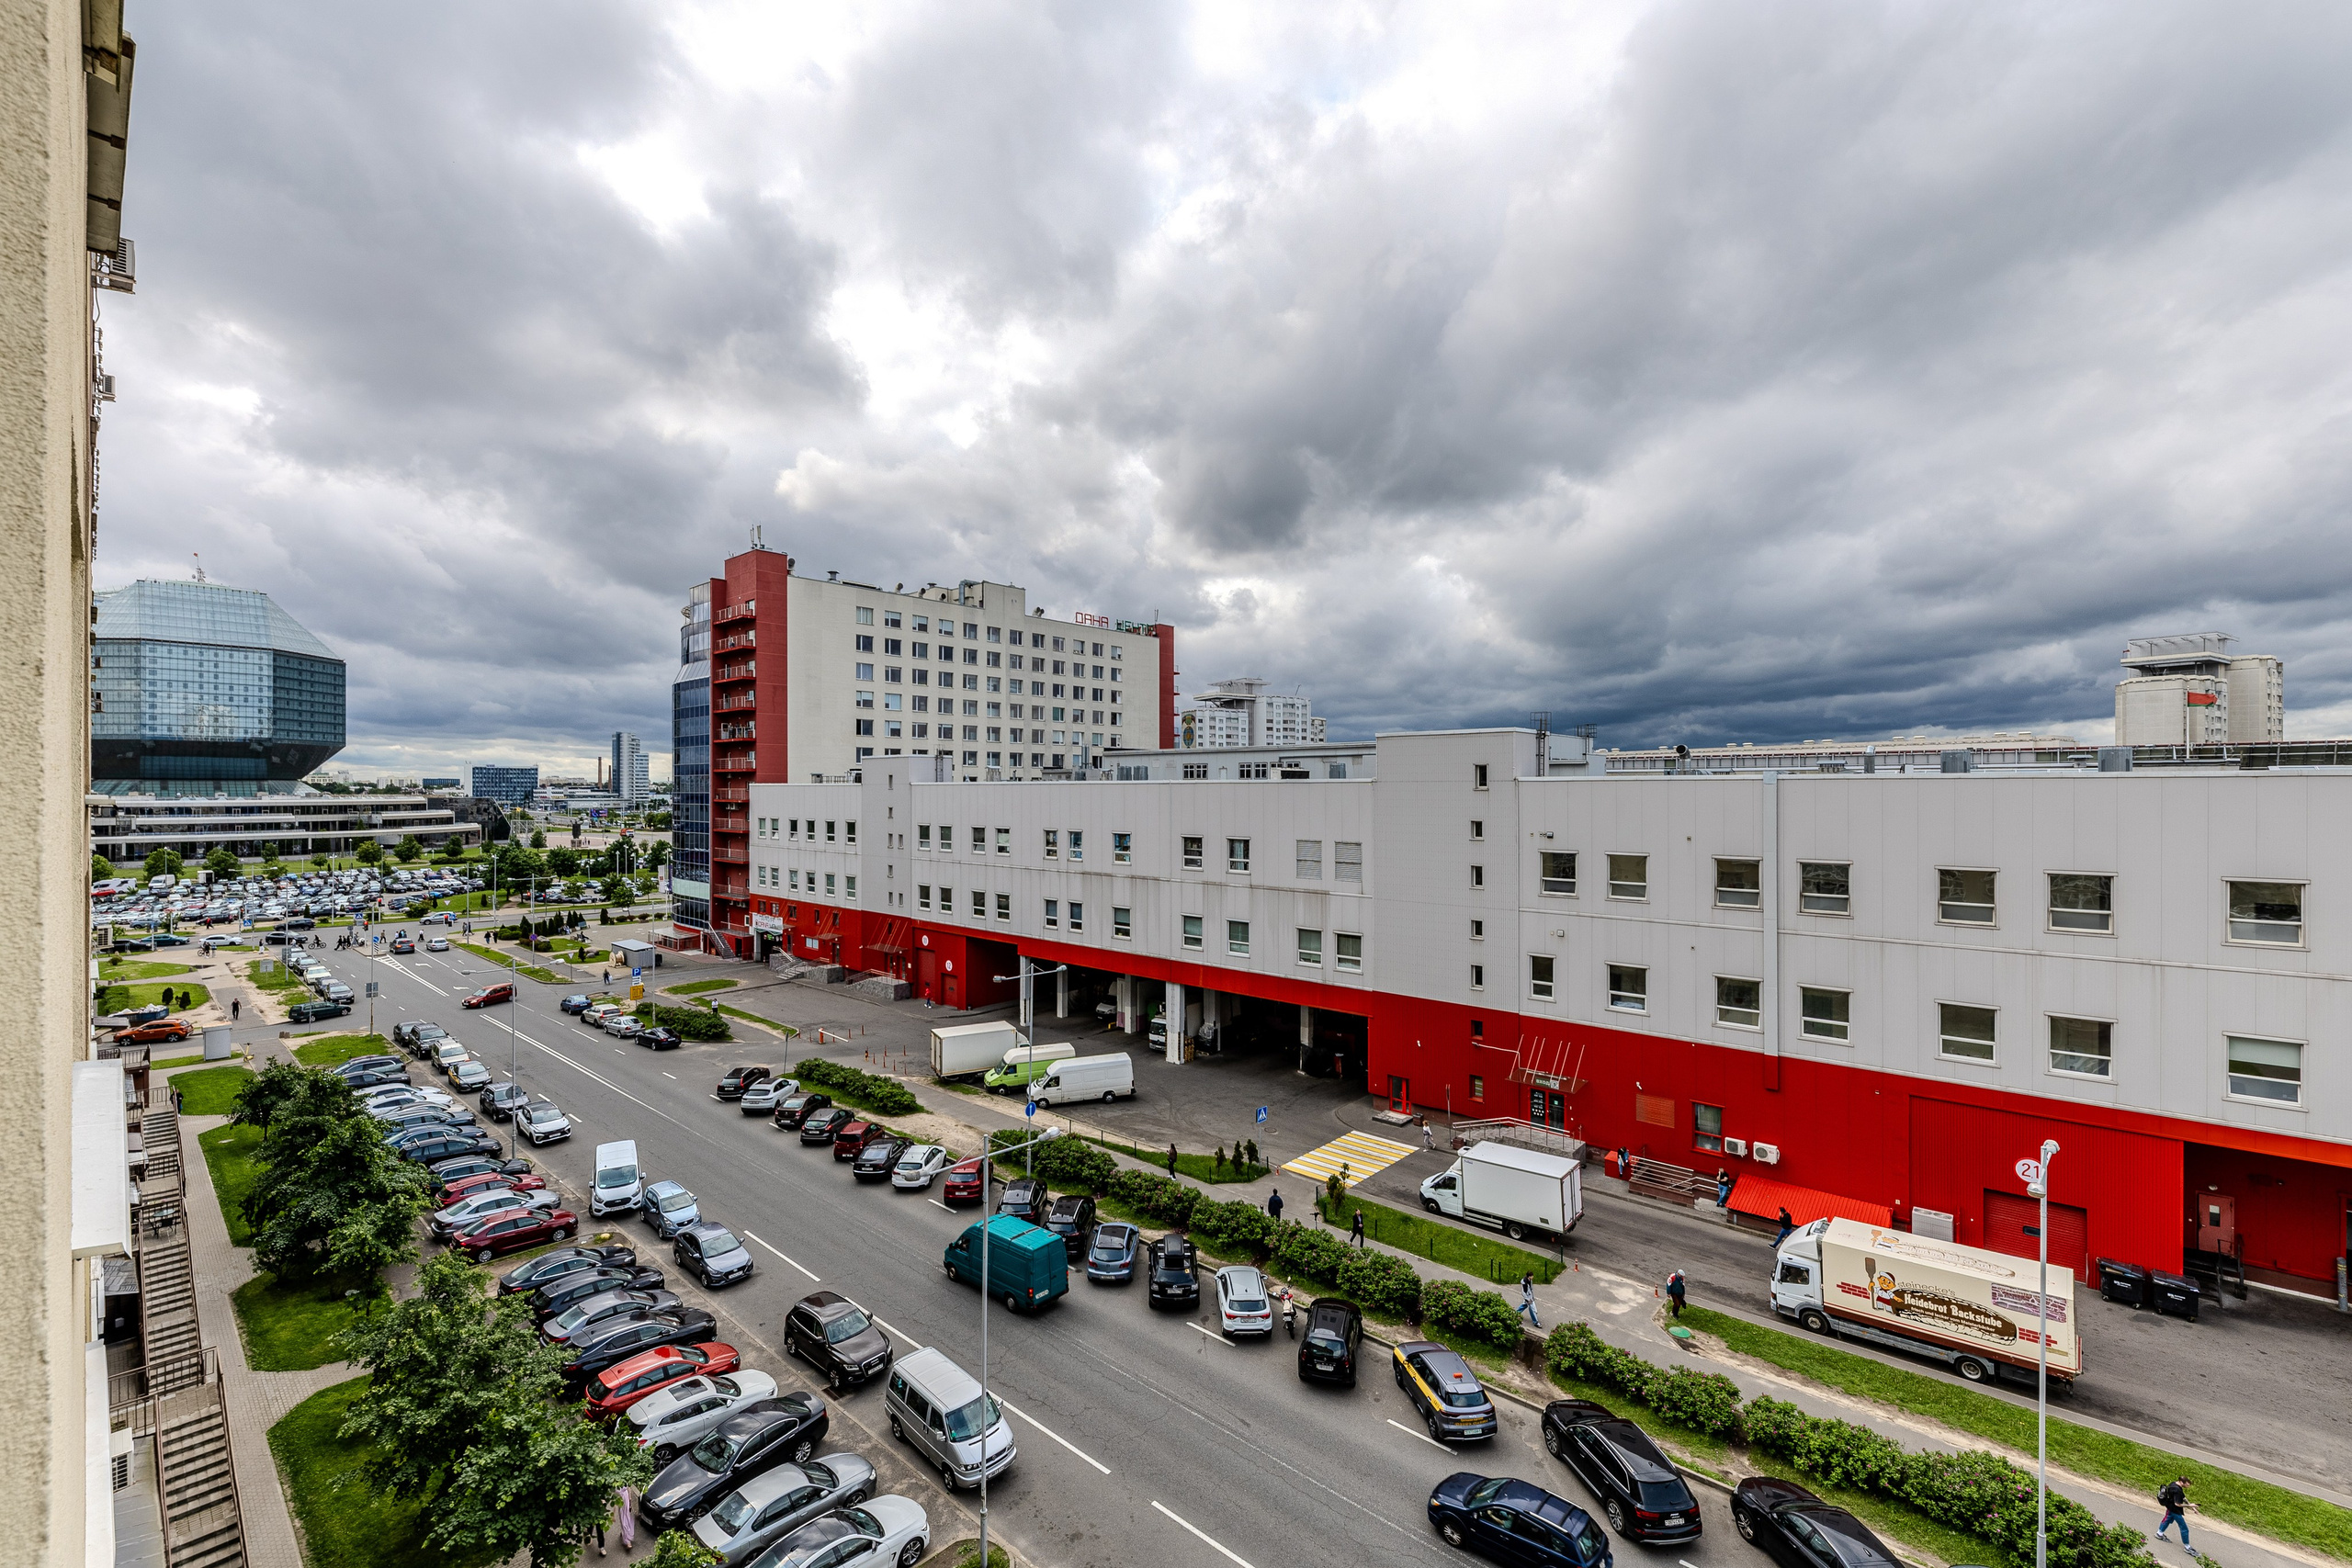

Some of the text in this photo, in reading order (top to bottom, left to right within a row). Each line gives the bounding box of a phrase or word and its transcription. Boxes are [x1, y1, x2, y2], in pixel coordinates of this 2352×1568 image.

[1075, 612, 1155, 637] ДАНА ЦЕНТР
[1897, 1281, 1956, 1296] steinecke's
[1904, 1293, 2003, 1328] Heidebrot Backstube
